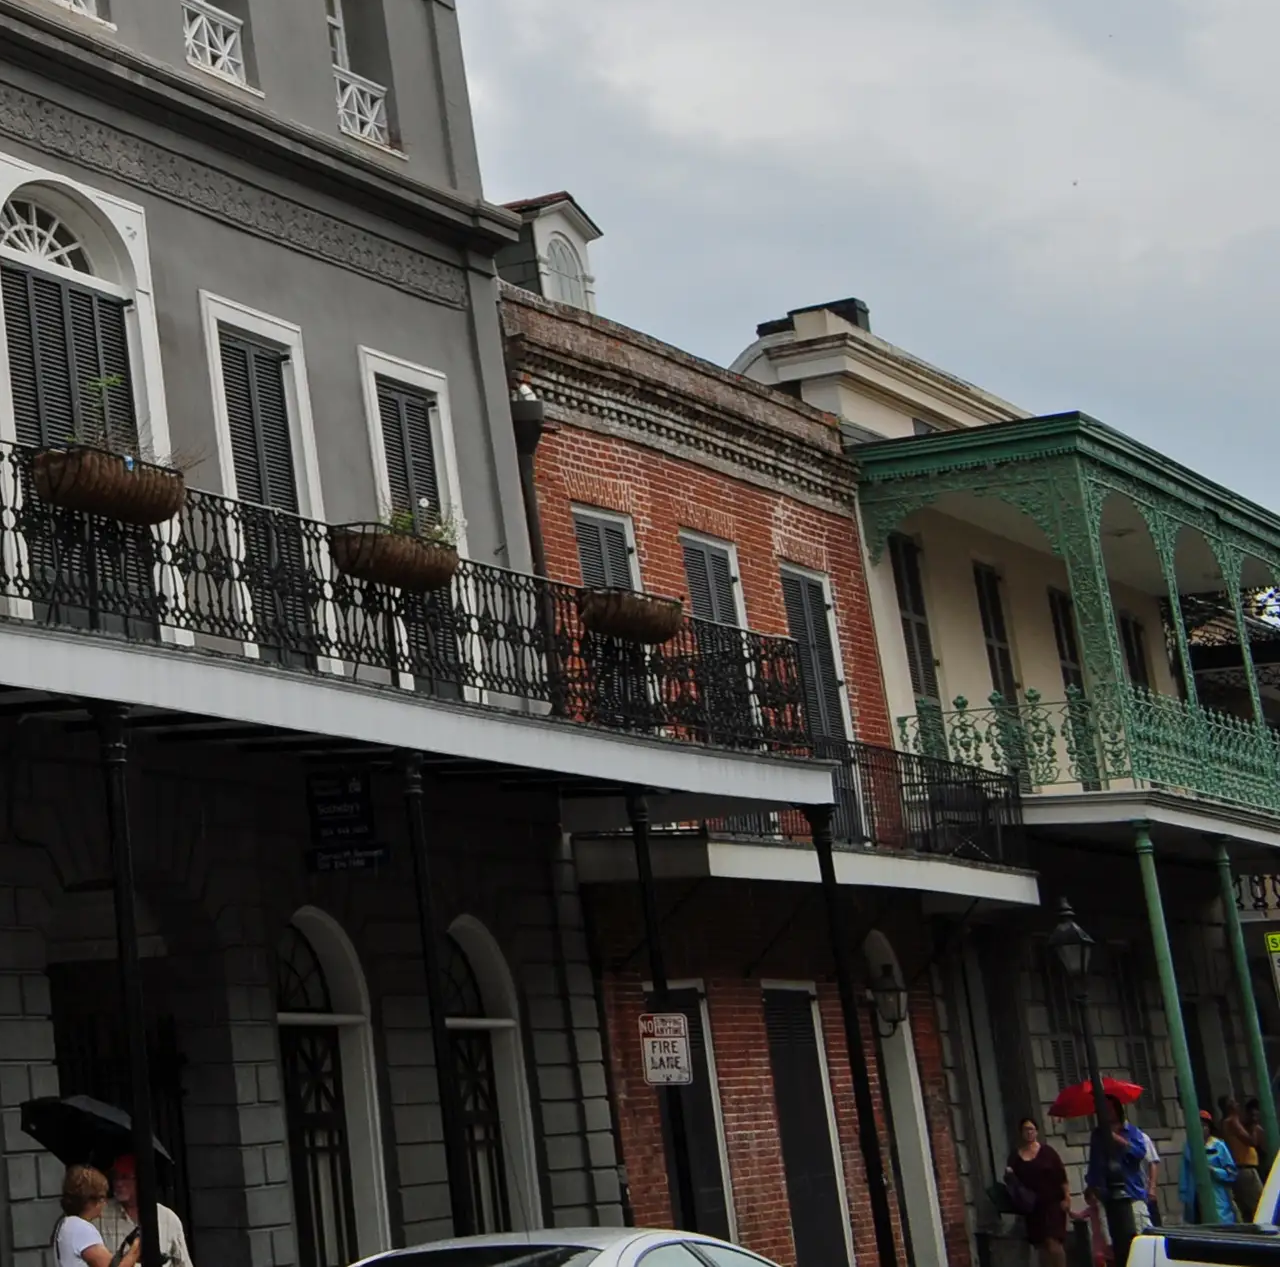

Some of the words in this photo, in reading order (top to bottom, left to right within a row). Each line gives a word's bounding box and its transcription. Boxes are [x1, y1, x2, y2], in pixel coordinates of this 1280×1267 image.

[639, 1020, 654, 1034] NO
[651, 1040, 679, 1054] FIRE
[650, 1056, 682, 1070] LANE
